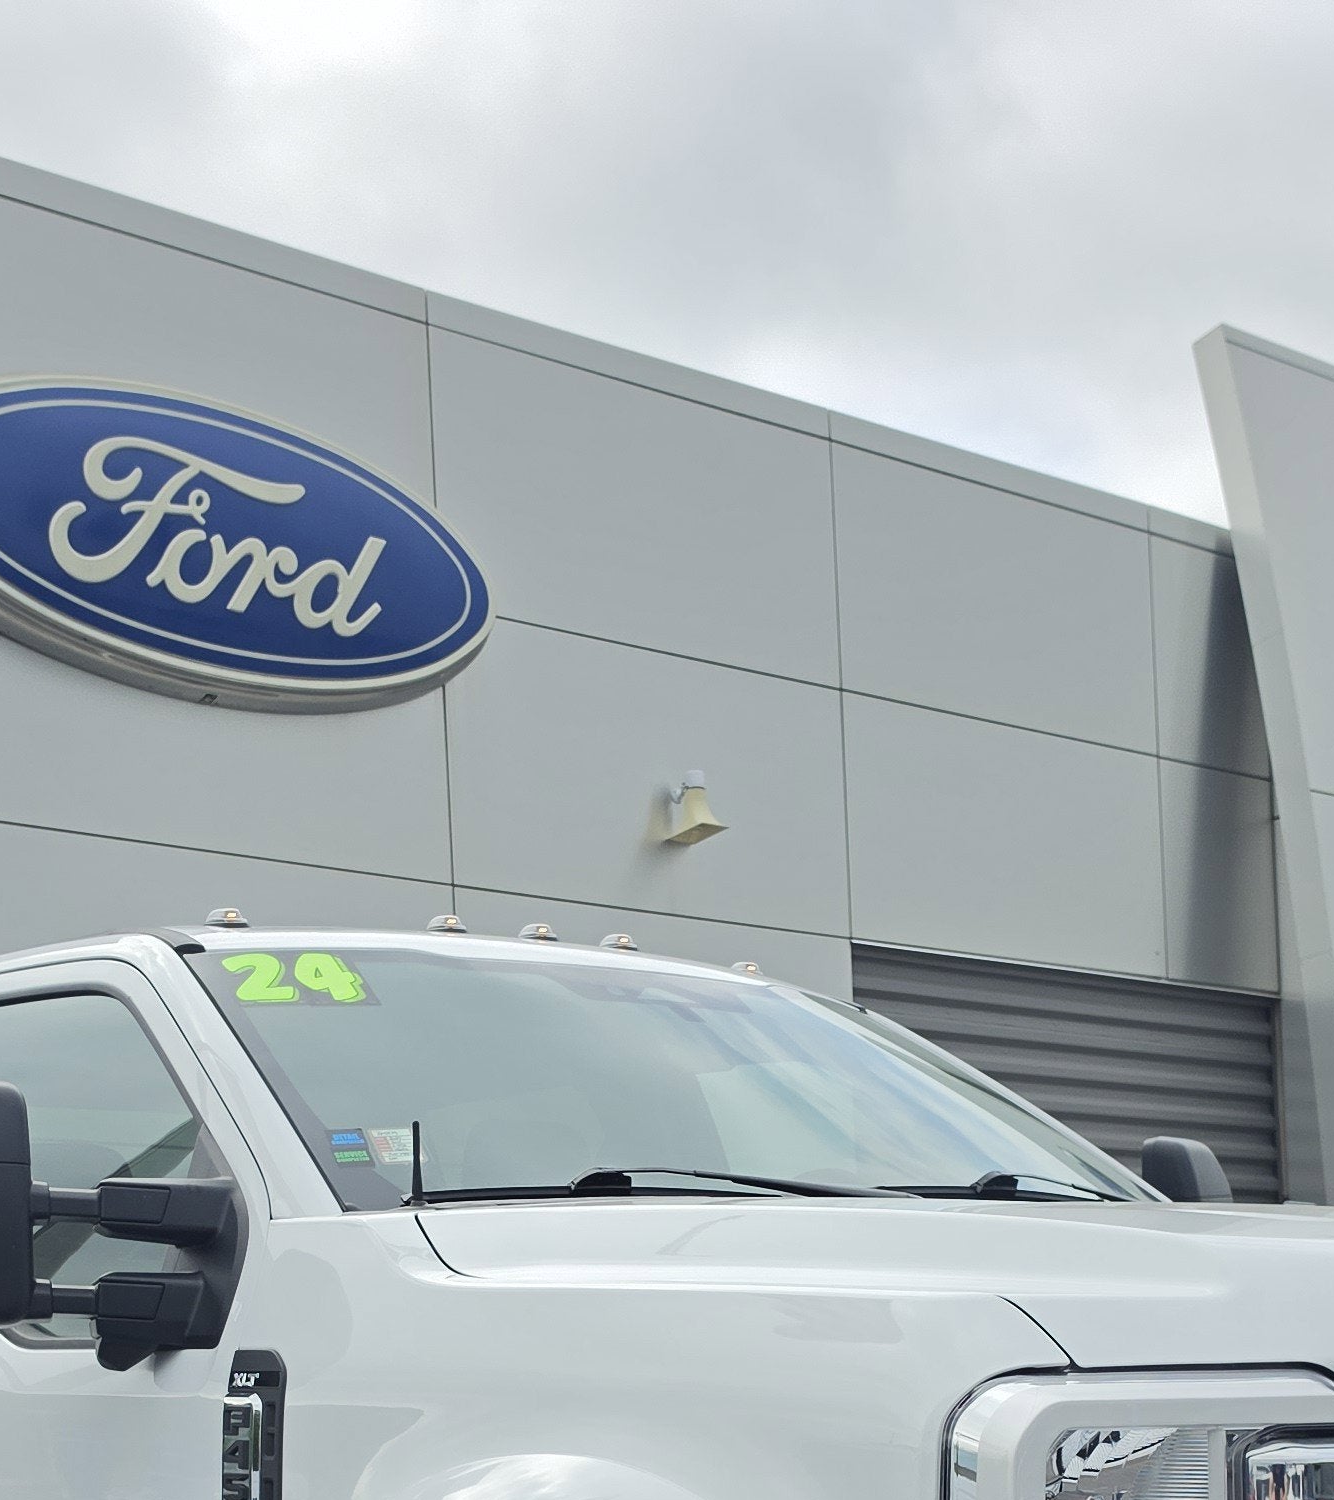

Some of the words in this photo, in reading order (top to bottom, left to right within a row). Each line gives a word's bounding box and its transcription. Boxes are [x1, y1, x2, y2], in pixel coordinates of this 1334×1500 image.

[48, 436, 387, 637] Ford
[222, 953, 367, 1003] 24
[231, 1372, 260, 1387] XLT
